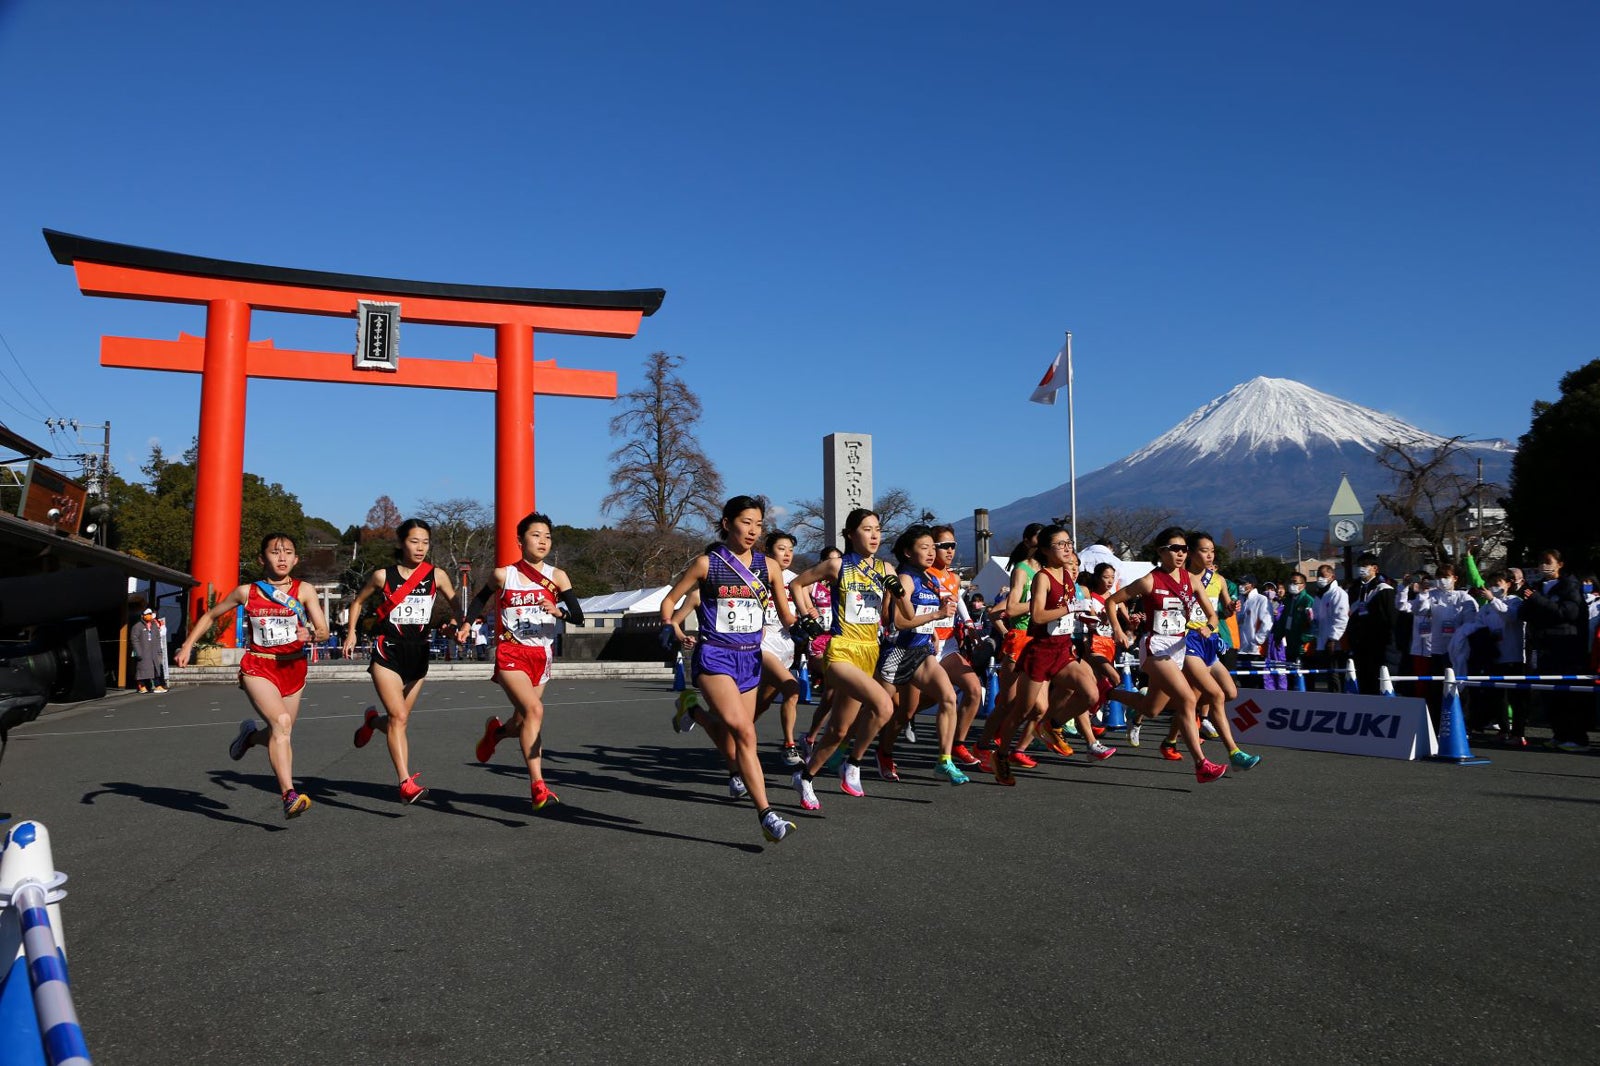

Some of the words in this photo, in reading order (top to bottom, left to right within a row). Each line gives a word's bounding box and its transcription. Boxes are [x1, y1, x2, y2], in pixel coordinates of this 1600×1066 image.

[396, 606, 425, 617] 19-1
[727, 611, 753, 624] 9-1
[1161, 619, 1181, 629] 4-1
[259, 627, 289, 639] 11-1
[1266, 707, 1402, 739] SUZUKI
